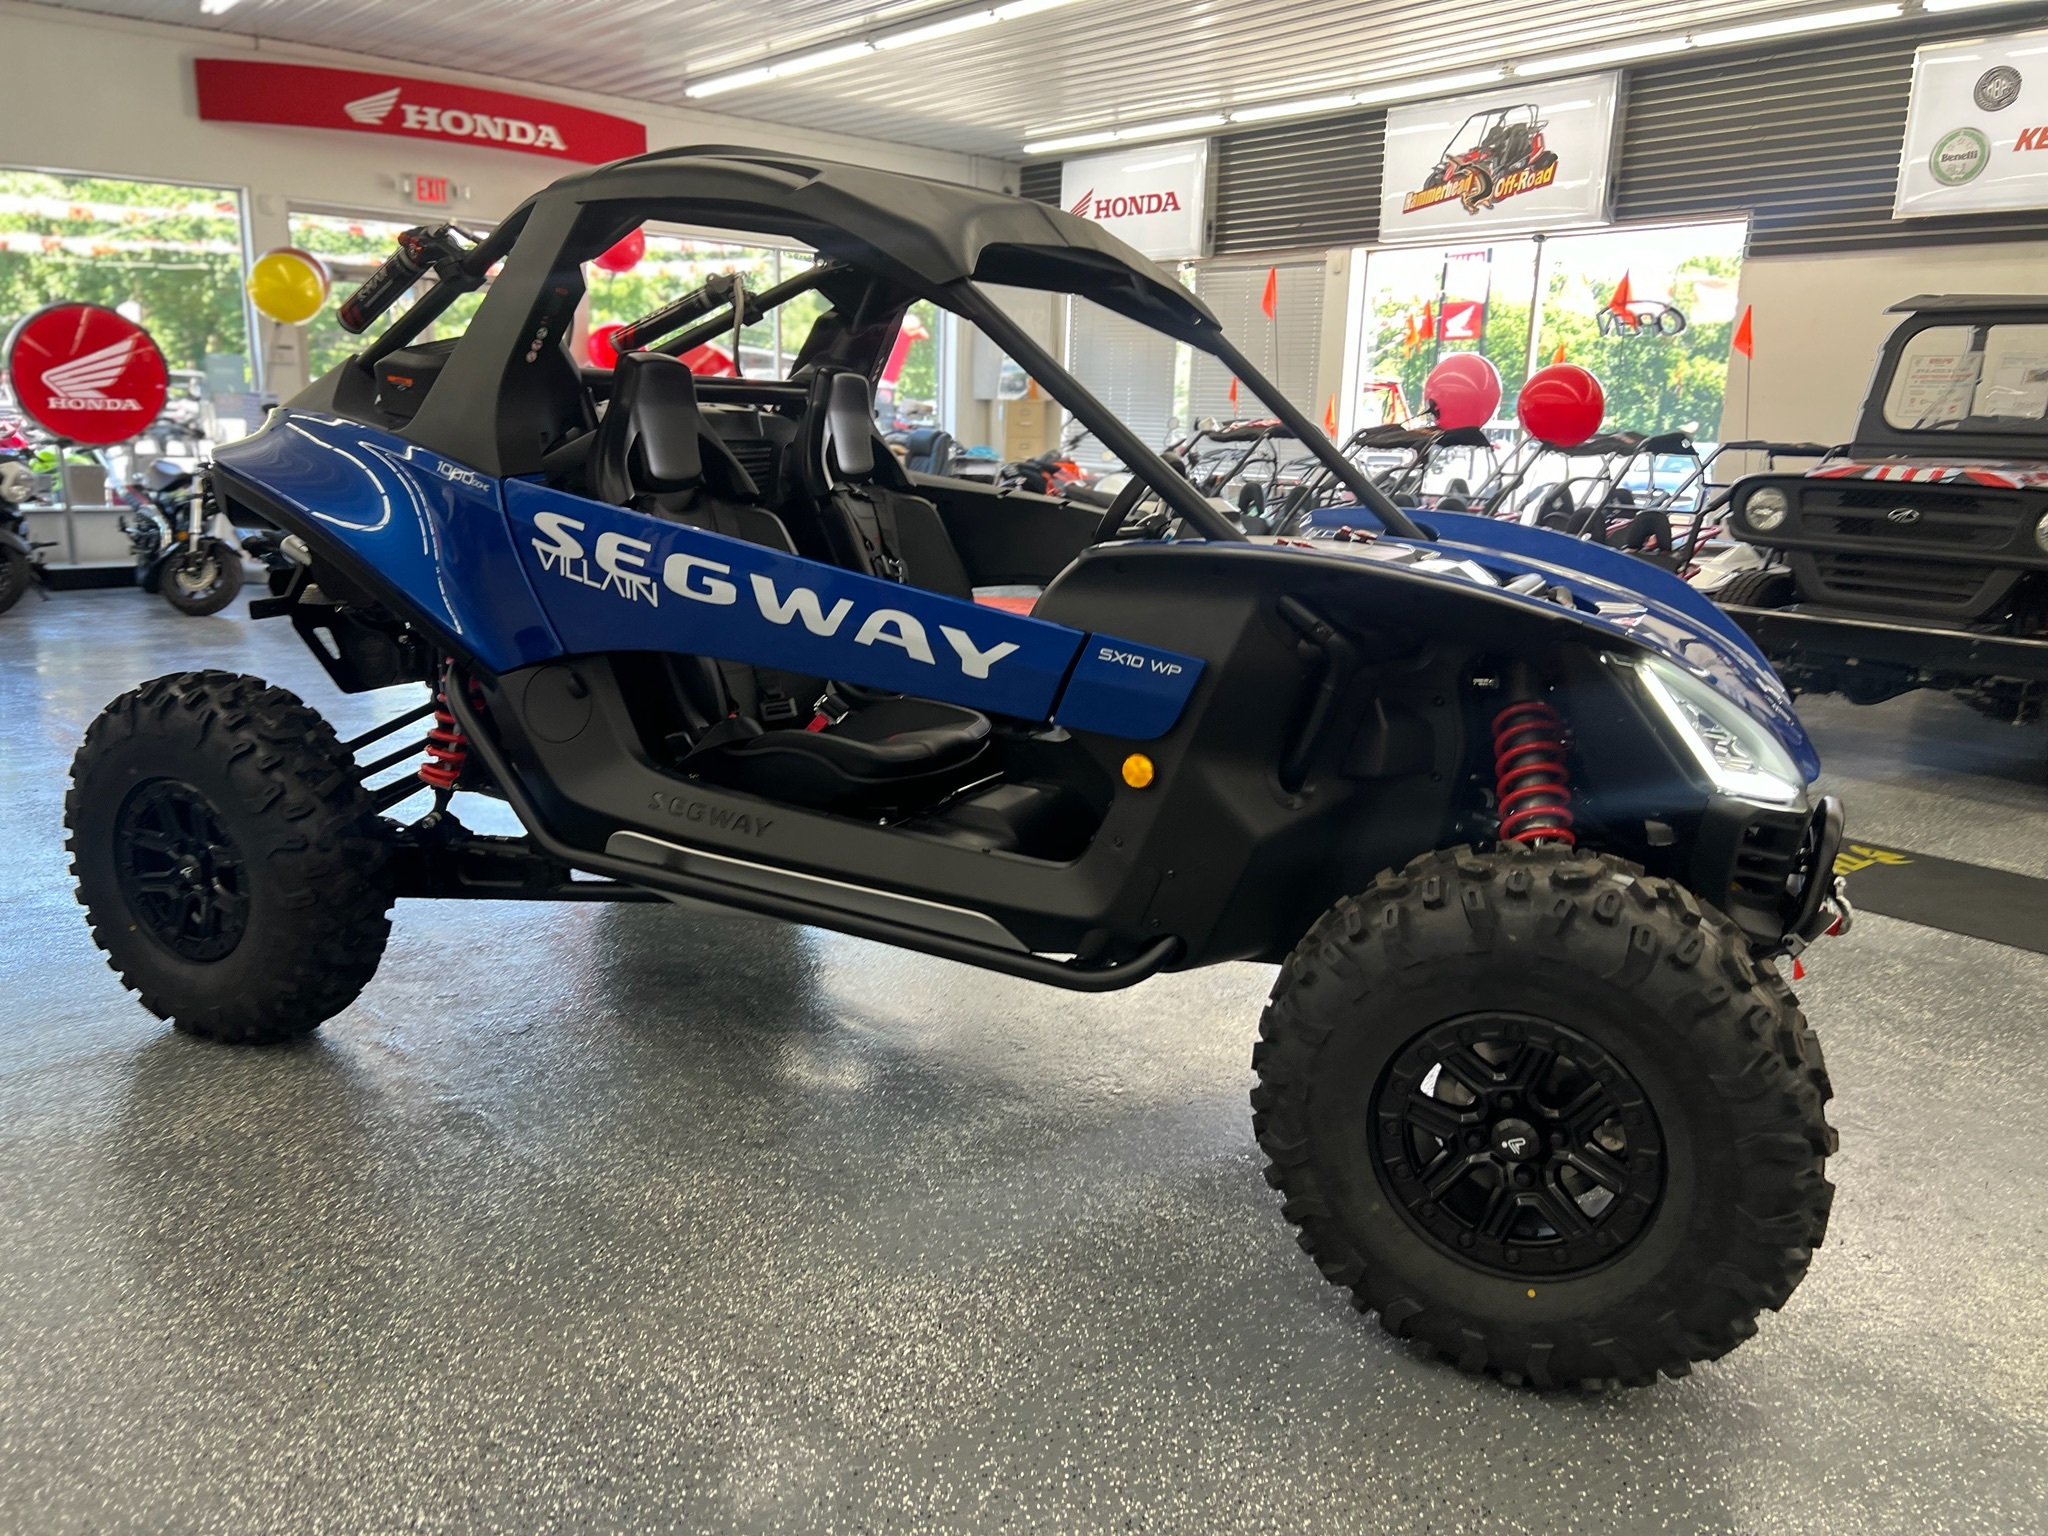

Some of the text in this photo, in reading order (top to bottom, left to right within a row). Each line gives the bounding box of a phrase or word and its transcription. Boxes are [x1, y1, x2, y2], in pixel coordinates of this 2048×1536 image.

[401, 104, 568, 151] HONDA
[1940, 149, 1979, 163] Benelli
[416, 175, 448, 203] EXIT
[1093, 190, 1182, 219] HONDA
[1403, 163, 1556, 211] Hammerhead Off-Road
[47, 397, 144, 412] HONDA
[531, 511, 1020, 679] SEGWAY
[534, 544, 658, 608] VILLAIN
[1098, 647, 1182, 675] SX10 WP
[648, 791, 774, 838] SEGWAY
